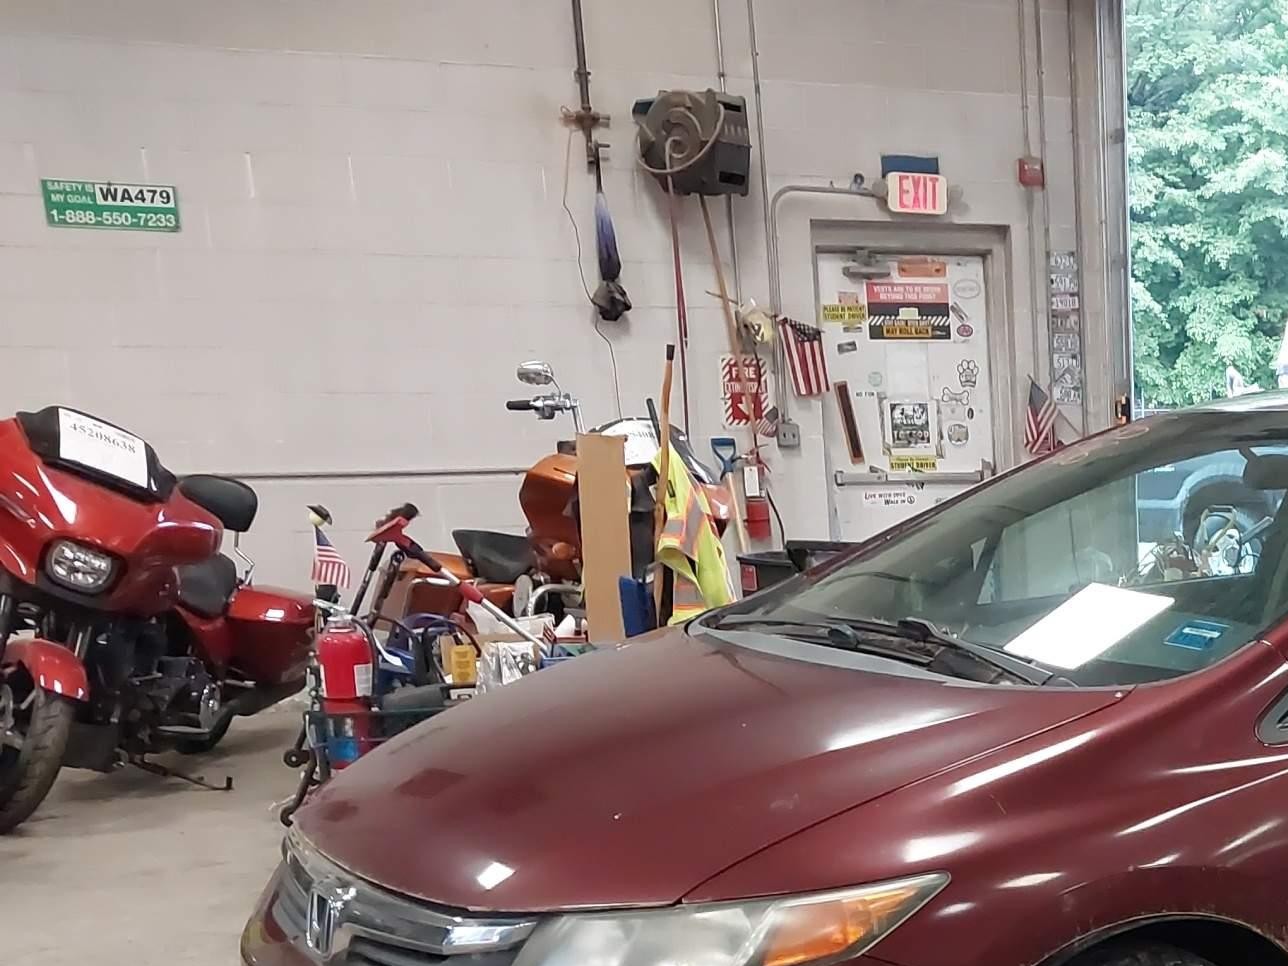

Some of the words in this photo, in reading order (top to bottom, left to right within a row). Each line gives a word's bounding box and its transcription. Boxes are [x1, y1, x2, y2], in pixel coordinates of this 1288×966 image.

[46, 181, 82, 192] SAFETY
[85, 183, 94, 192] IS
[99, 186, 171, 205] WA479
[899, 175, 939, 210] EXIT
[51, 193, 65, 203] MY
[66, 194, 94, 204] GOAL
[50, 209, 176, 227] 1-888-550-7233
[731, 367, 757, 379] FRE
[69, 423, 136, 454] 45208638
